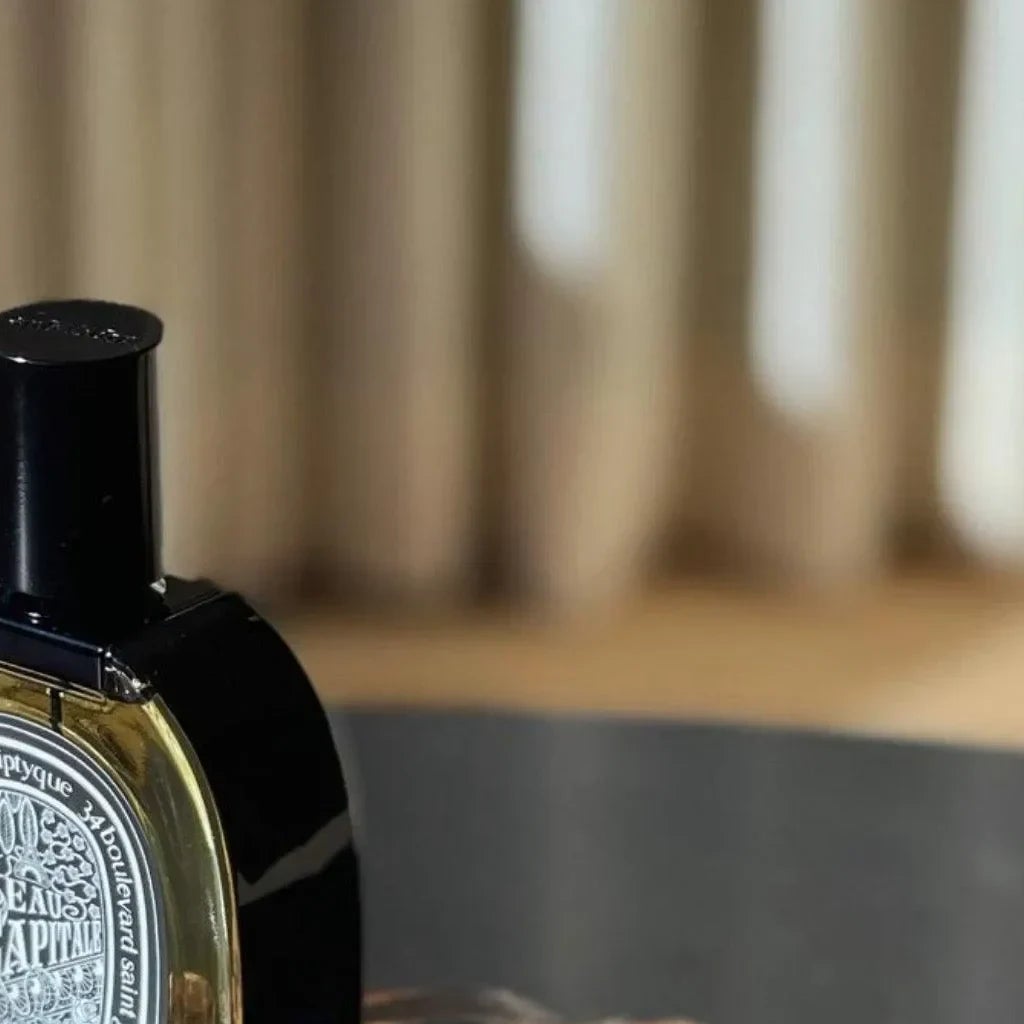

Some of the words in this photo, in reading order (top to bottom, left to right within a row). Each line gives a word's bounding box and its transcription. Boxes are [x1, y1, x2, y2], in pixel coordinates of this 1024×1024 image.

[6, 876, 63, 919] EAU
[77, 799, 106, 831] 34
[99, 825, 139, 955] boulevard
[119, 957, 139, 1019] saint
